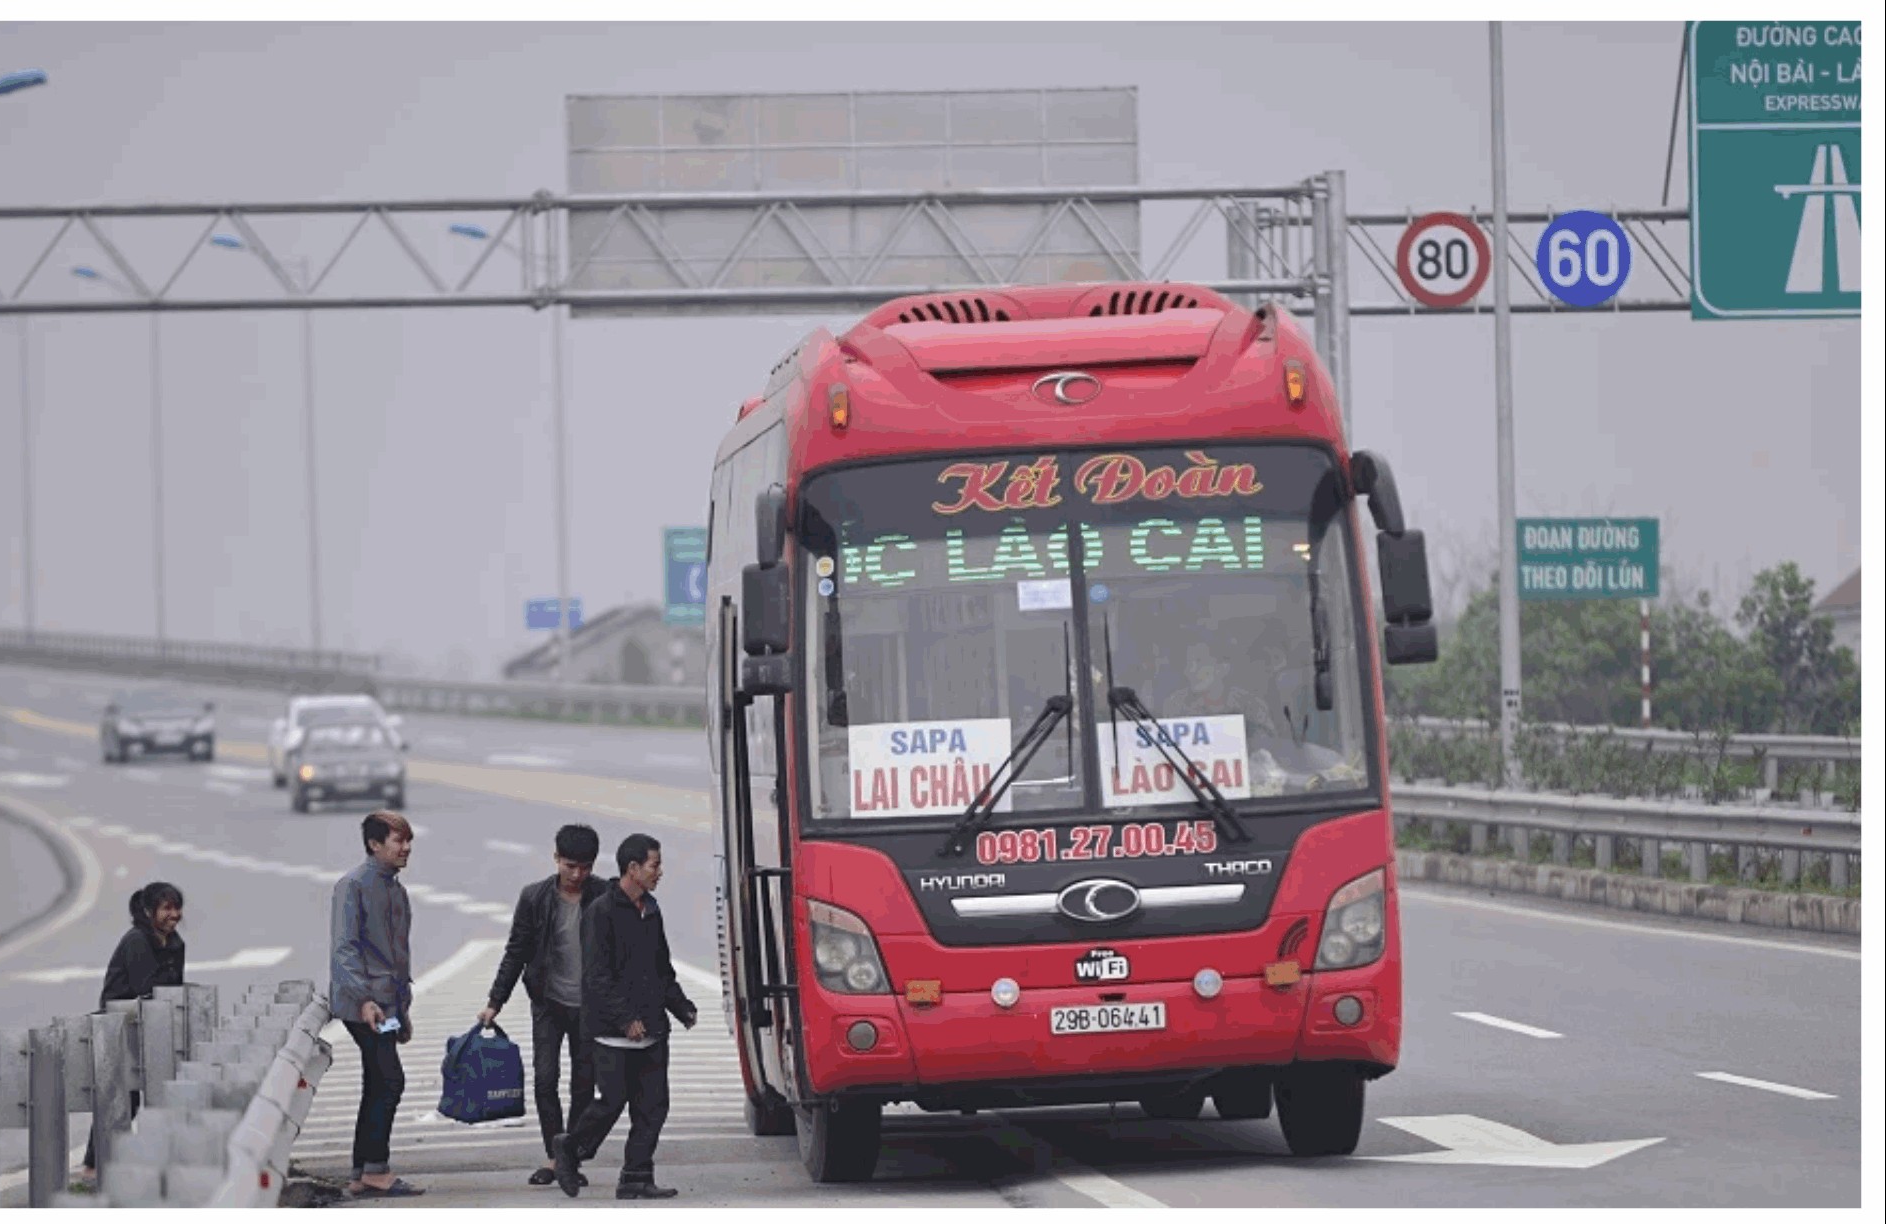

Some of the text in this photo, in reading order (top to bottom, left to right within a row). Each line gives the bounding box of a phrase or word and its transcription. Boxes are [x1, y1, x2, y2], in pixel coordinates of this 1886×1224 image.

[1730, 58, 1769, 88] NỘI
[1417, 239, 1469, 280] 80
[1548, 229, 1619, 288] 60
[931, 450, 1264, 514] Kết Đoàn
[1129, 516, 1265, 572] CAI
[1521, 564, 1567, 590] THEO
[890, 727, 967, 756] SAPA
[1135, 721, 1210, 748] SAPA
[853, 757, 993, 812] LAI CHÂU
[976, 820, 1217, 865] 0981.27.00.45
[920, 873, 1005, 890] HYUNDAI
[1204, 860, 1272, 876] THACO
